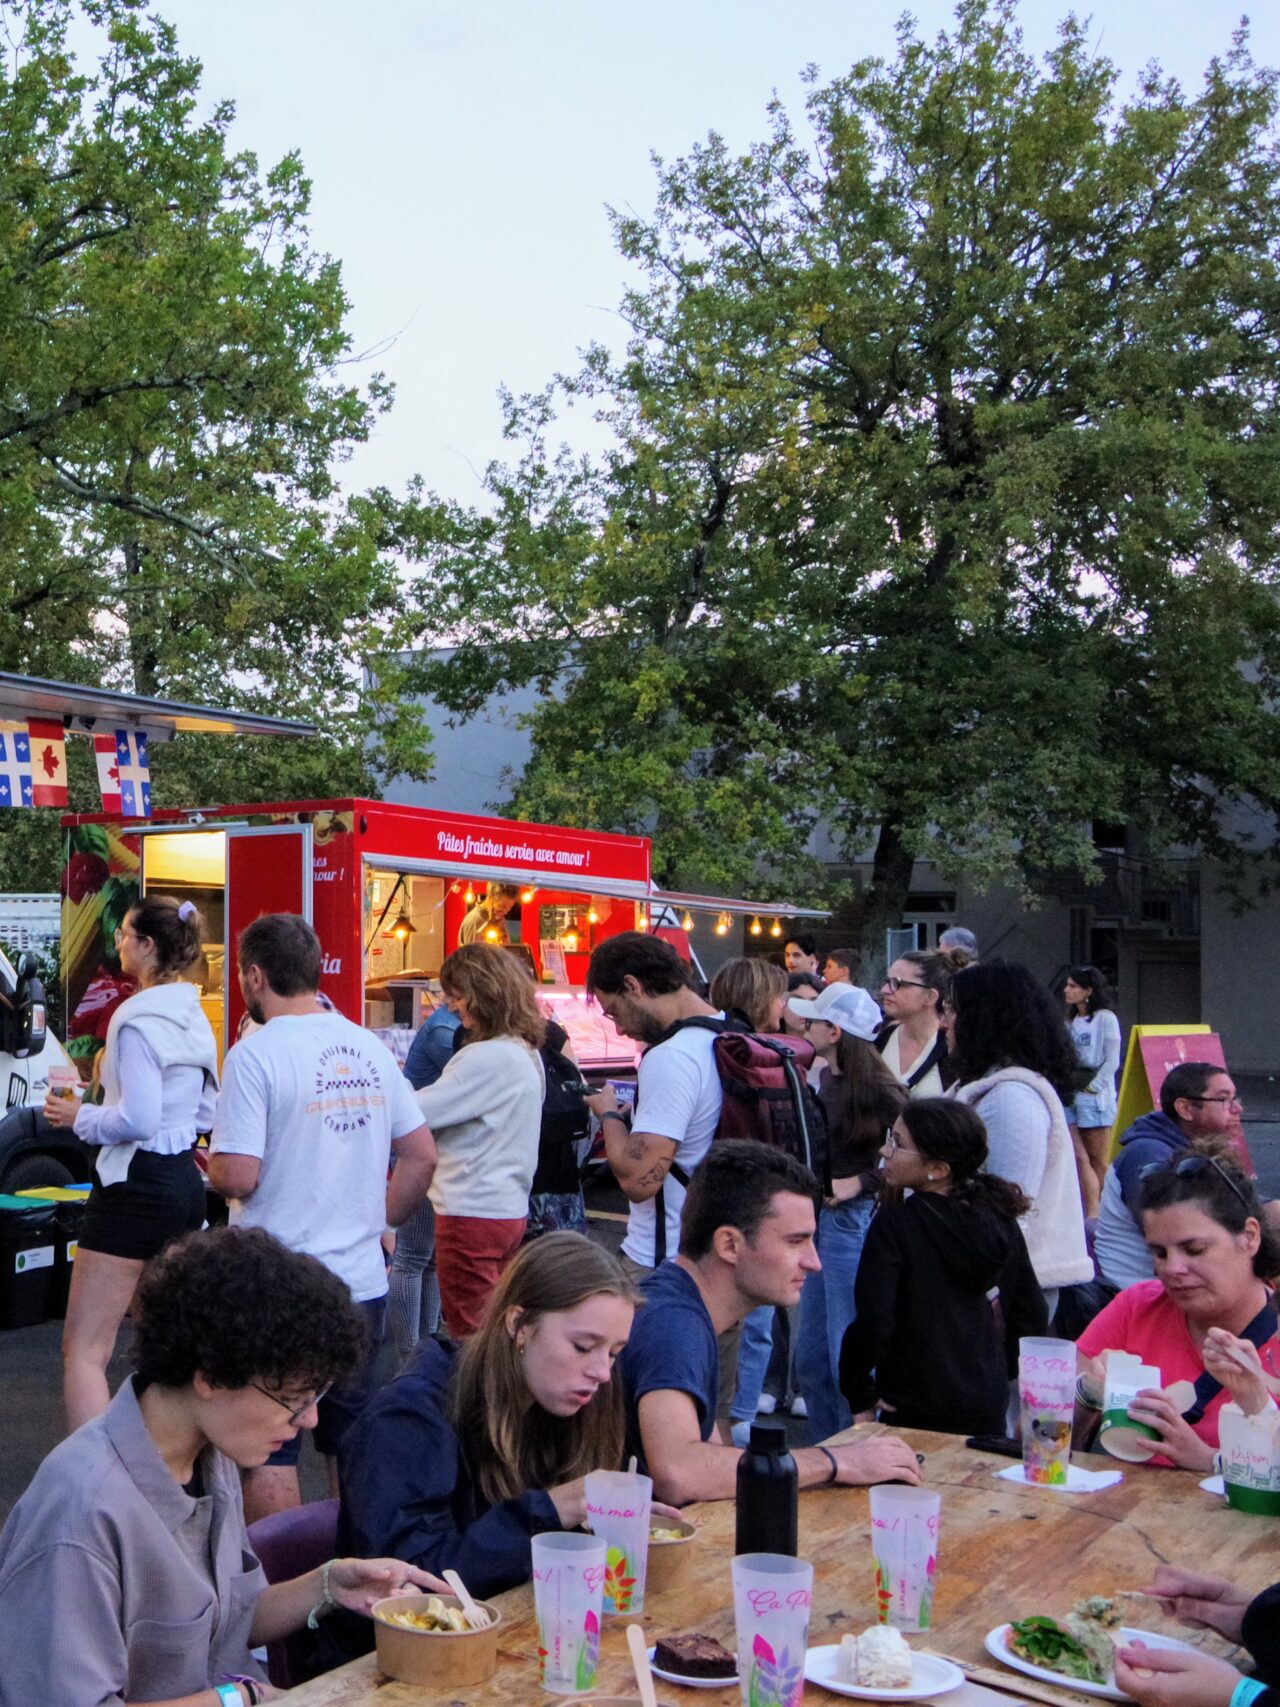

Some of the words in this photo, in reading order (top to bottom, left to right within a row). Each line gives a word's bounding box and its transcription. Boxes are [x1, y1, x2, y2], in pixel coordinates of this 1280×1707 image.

[437, 831, 465, 853] Pâtes
[463, 835, 503, 859] fraîches
[505, 842, 534, 862] servies
[535, 850, 555, 864] avec
[556, 851, 585, 867] amour
